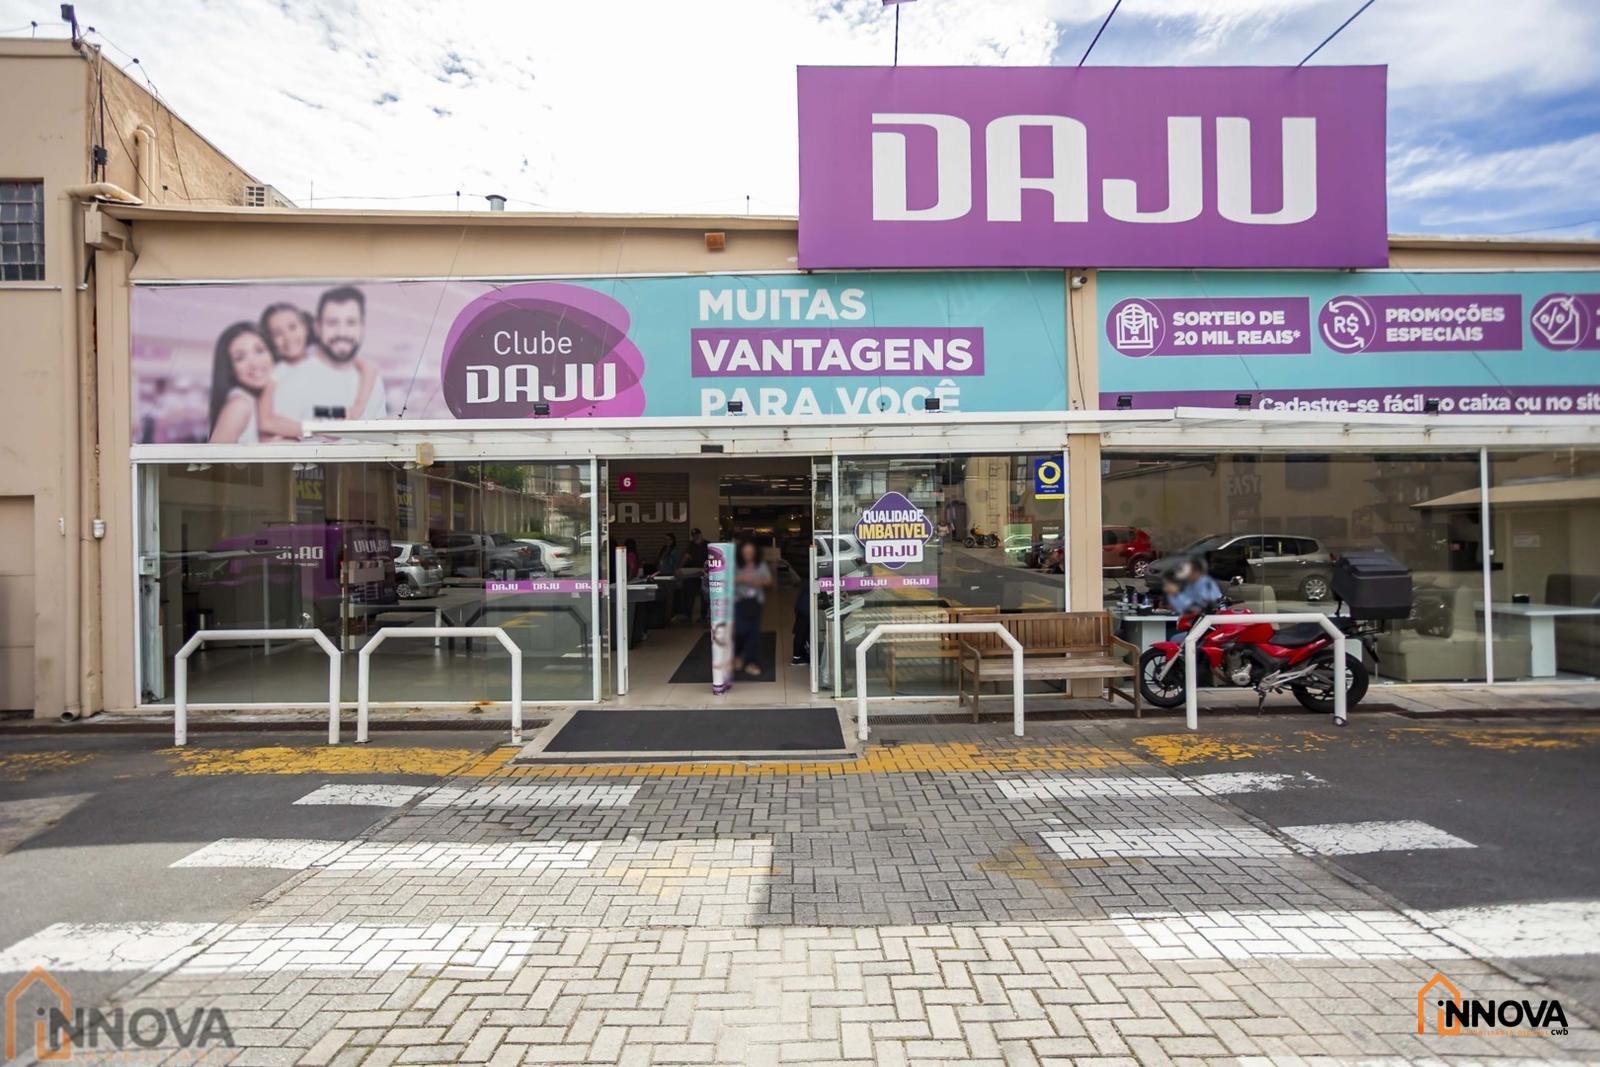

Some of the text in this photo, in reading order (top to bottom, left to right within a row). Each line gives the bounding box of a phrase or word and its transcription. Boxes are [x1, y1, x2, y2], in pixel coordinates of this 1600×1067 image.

[872, 112, 1317, 225] DAJU
[698, 288, 866, 321] MUITAS
[1173, 310, 1285, 326] SORTEIO DE
[1385, 304, 1505, 325] PROMOÇÕES
[493, 330, 573, 355] Clube
[1173, 331, 1198, 345] 20
[1202, 330, 1234, 345] MIL
[1386, 327, 1483, 342] ESPECIAIS
[698, 338, 974, 372] VANTAGENS
[466, 362, 616, 403] DAJU
[700, 378, 961, 416] PARA VOCÊ
[1259, 397, 1379, 412] Cadastre-se
[1383, 394, 1424, 412] fácil
[1458, 393, 1511, 411] caixa
[1515, 396, 1541, 411] ou
[1546, 396, 1573, 411] no
[623, 477, 632, 487] 6
[862, 509, 924, 524] QUALIDADE
[871, 545, 917, 557] DAJU
[492, 583, 518, 591] DAJU
[860, 579, 887, 587] DAJU
[903, 578, 930, 586] DAJU
